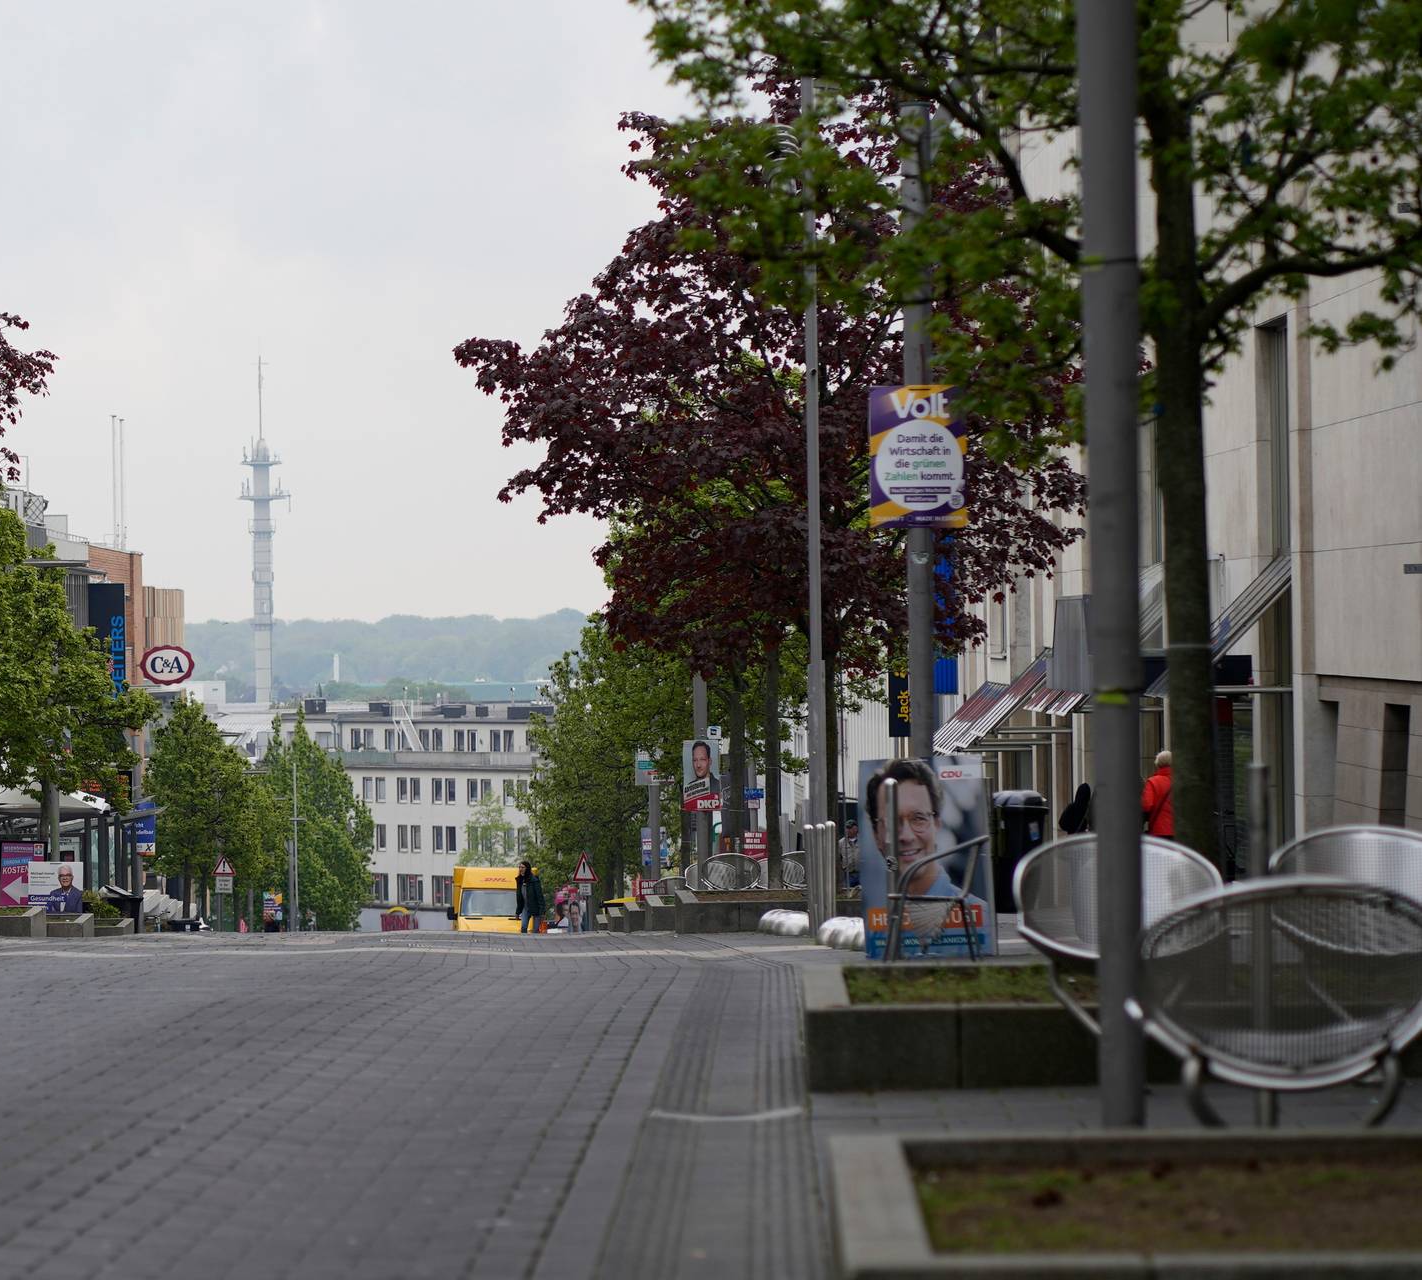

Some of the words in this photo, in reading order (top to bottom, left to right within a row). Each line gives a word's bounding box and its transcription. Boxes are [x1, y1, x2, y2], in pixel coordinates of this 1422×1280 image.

[890, 393, 950, 418] Volt
[897, 433, 928, 443] Damit
[929, 433, 944, 443] die
[889, 446, 941, 456] Wirtschaft
[942, 446, 951, 456] in
[894, 459, 911, 468] die
[912, 459, 946, 470] grünen
[884, 471, 918, 481] Zahlen
[920, 471, 956, 481] kommt.
[150, 656, 185, 674] C&A
[897, 690, 910, 723] Jack
[940, 770, 963, 779] CDU
[698, 800, 719, 809] DKP
